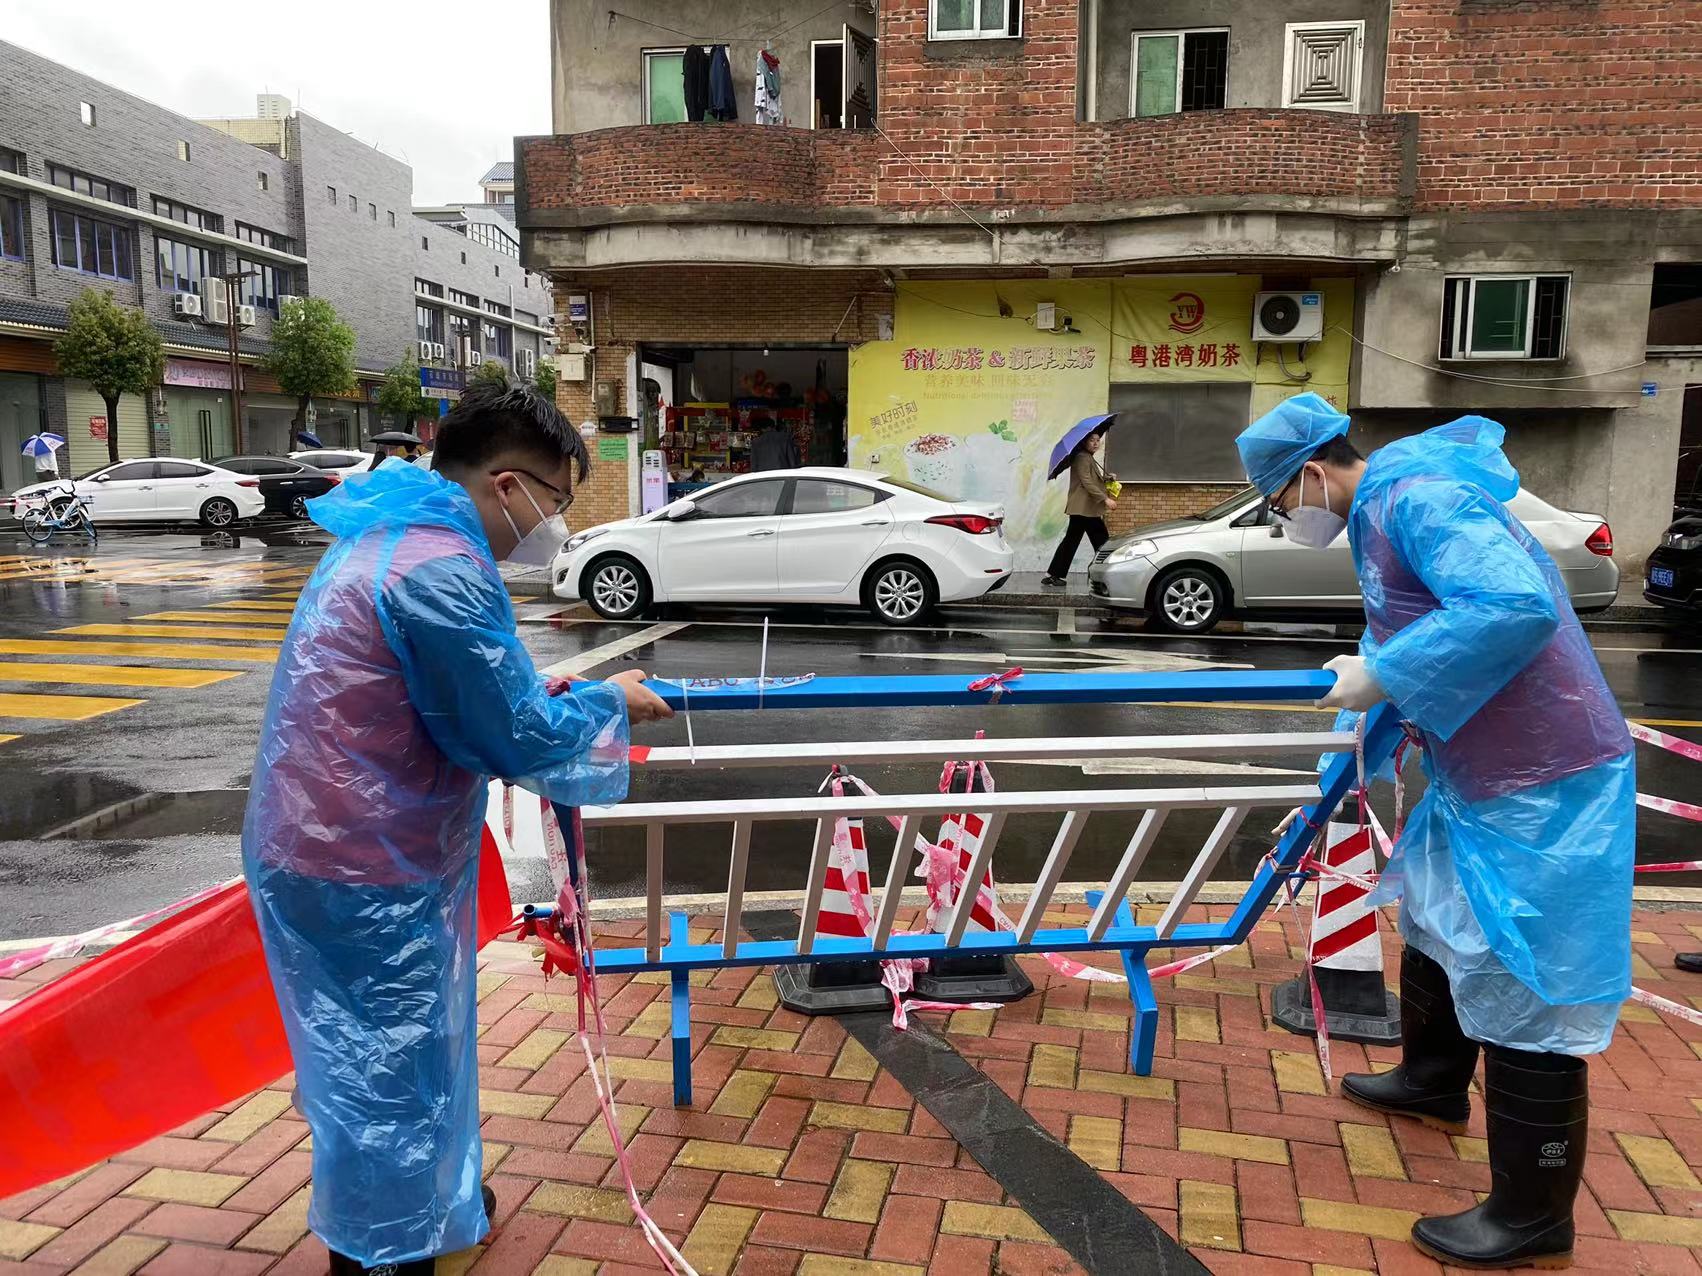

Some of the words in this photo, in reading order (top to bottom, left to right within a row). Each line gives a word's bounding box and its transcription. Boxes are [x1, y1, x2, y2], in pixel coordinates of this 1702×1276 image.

[1176, 304, 1198, 319] YW
[901, 346, 984, 370] 香浓奶茶
[988, 349, 1005, 369] &
[1008, 345, 1096, 370] 新鲜果茶
[1128, 343, 1241, 368] 粤港湾奶茶
[869, 399, 919, 430] 美好时刻
